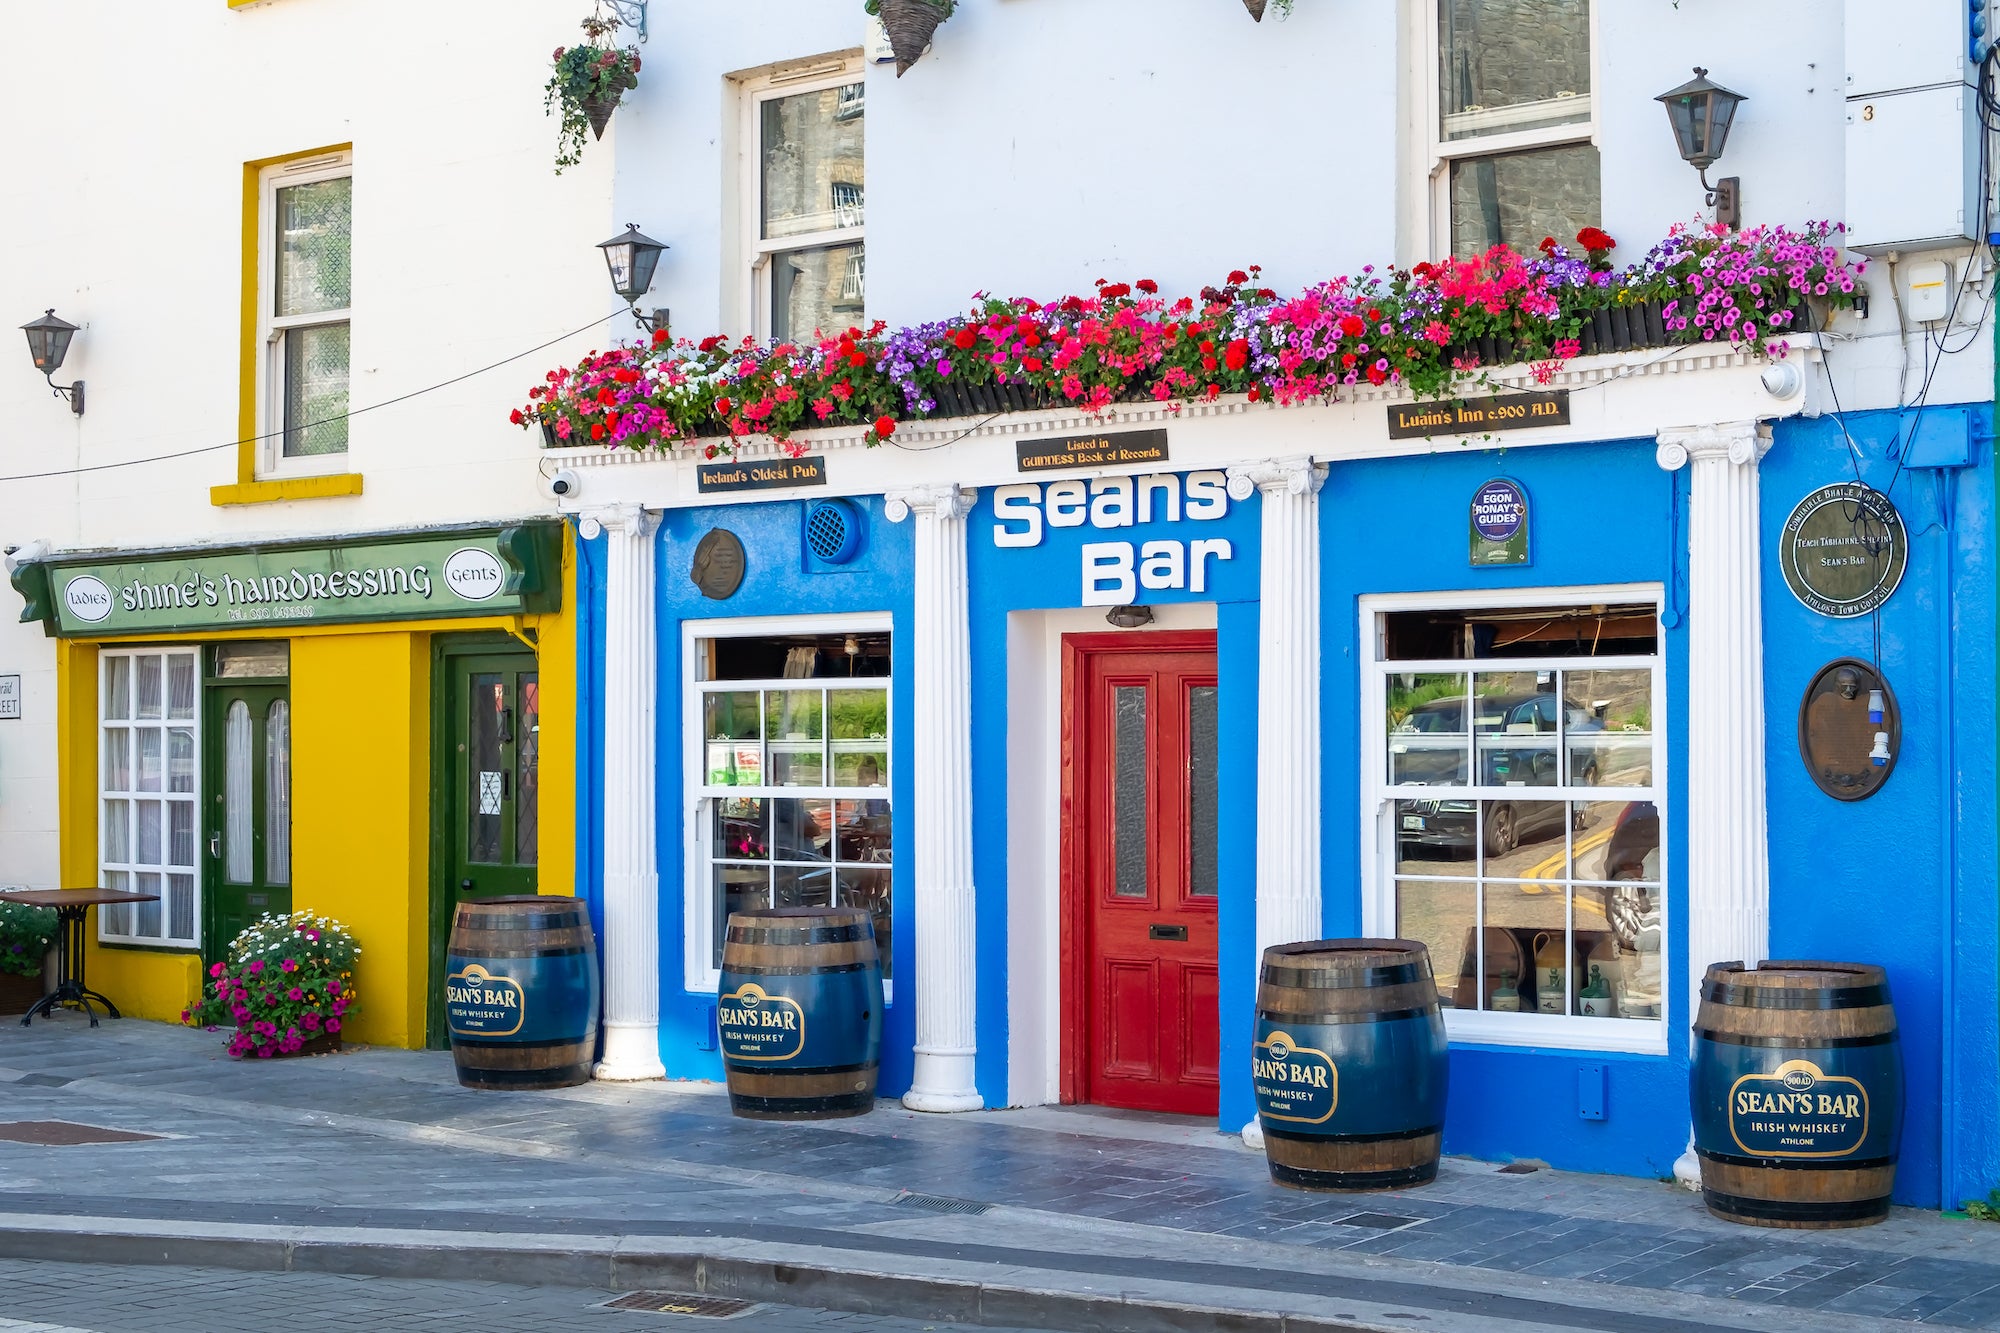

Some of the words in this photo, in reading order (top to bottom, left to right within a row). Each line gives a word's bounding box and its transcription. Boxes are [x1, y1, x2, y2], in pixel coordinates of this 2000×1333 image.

[1863, 105, 1874, 121] 3
[1399, 410, 1453, 429] Luain's
[1457, 407, 1484, 423] Inn
[1487, 403, 1526, 421] c.900
[1530, 401, 1560, 416] A.D.
[1066, 439, 1096, 451] Listed
[1099, 438, 1109, 448] in
[1022, 454, 1075, 467] GUINNESS
[1077, 451, 1103, 463] Book
[1106, 449, 1117, 461] of
[1120, 447, 1161, 460] Records
[702, 470, 748, 485] Ireland's
[750, 468, 789, 481] Oldest
[792, 464, 818, 478] Pub
[1483, 493, 1512, 503] EGON
[993, 471, 1228, 548] Seans
[1475, 503, 1521, 515] RONAY'S
[1478, 513, 1517, 524] GUIDES
[1850, 555, 1866, 565] BAR
[1081, 538, 1233, 607] Bar
[250, 607, 270, 620] 090
[1838, 604, 1860, 615] TOWN
[484, 989, 517, 1008] BAR
[468, 1010, 505, 1019] WHISKEY
[720, 1007, 759, 1027] SEAN'S
[761, 1010, 797, 1030] BAR
[726, 1031, 742, 1040] IRISH
[743, 1033, 785, 1042] WHISKEY
[1290, 1063, 1329, 1088] BAR
[1273, 1087, 1314, 1102] WHISKEY
[1737, 1091, 1813, 1115] SEAN'S
[1817, 1094, 1861, 1118] BAR
[1751, 1122, 1785, 1132] IRISH
[1789, 1123, 1847, 1133] WHISKEY
[1780, 1138, 1815, 1146] ATHLONE
